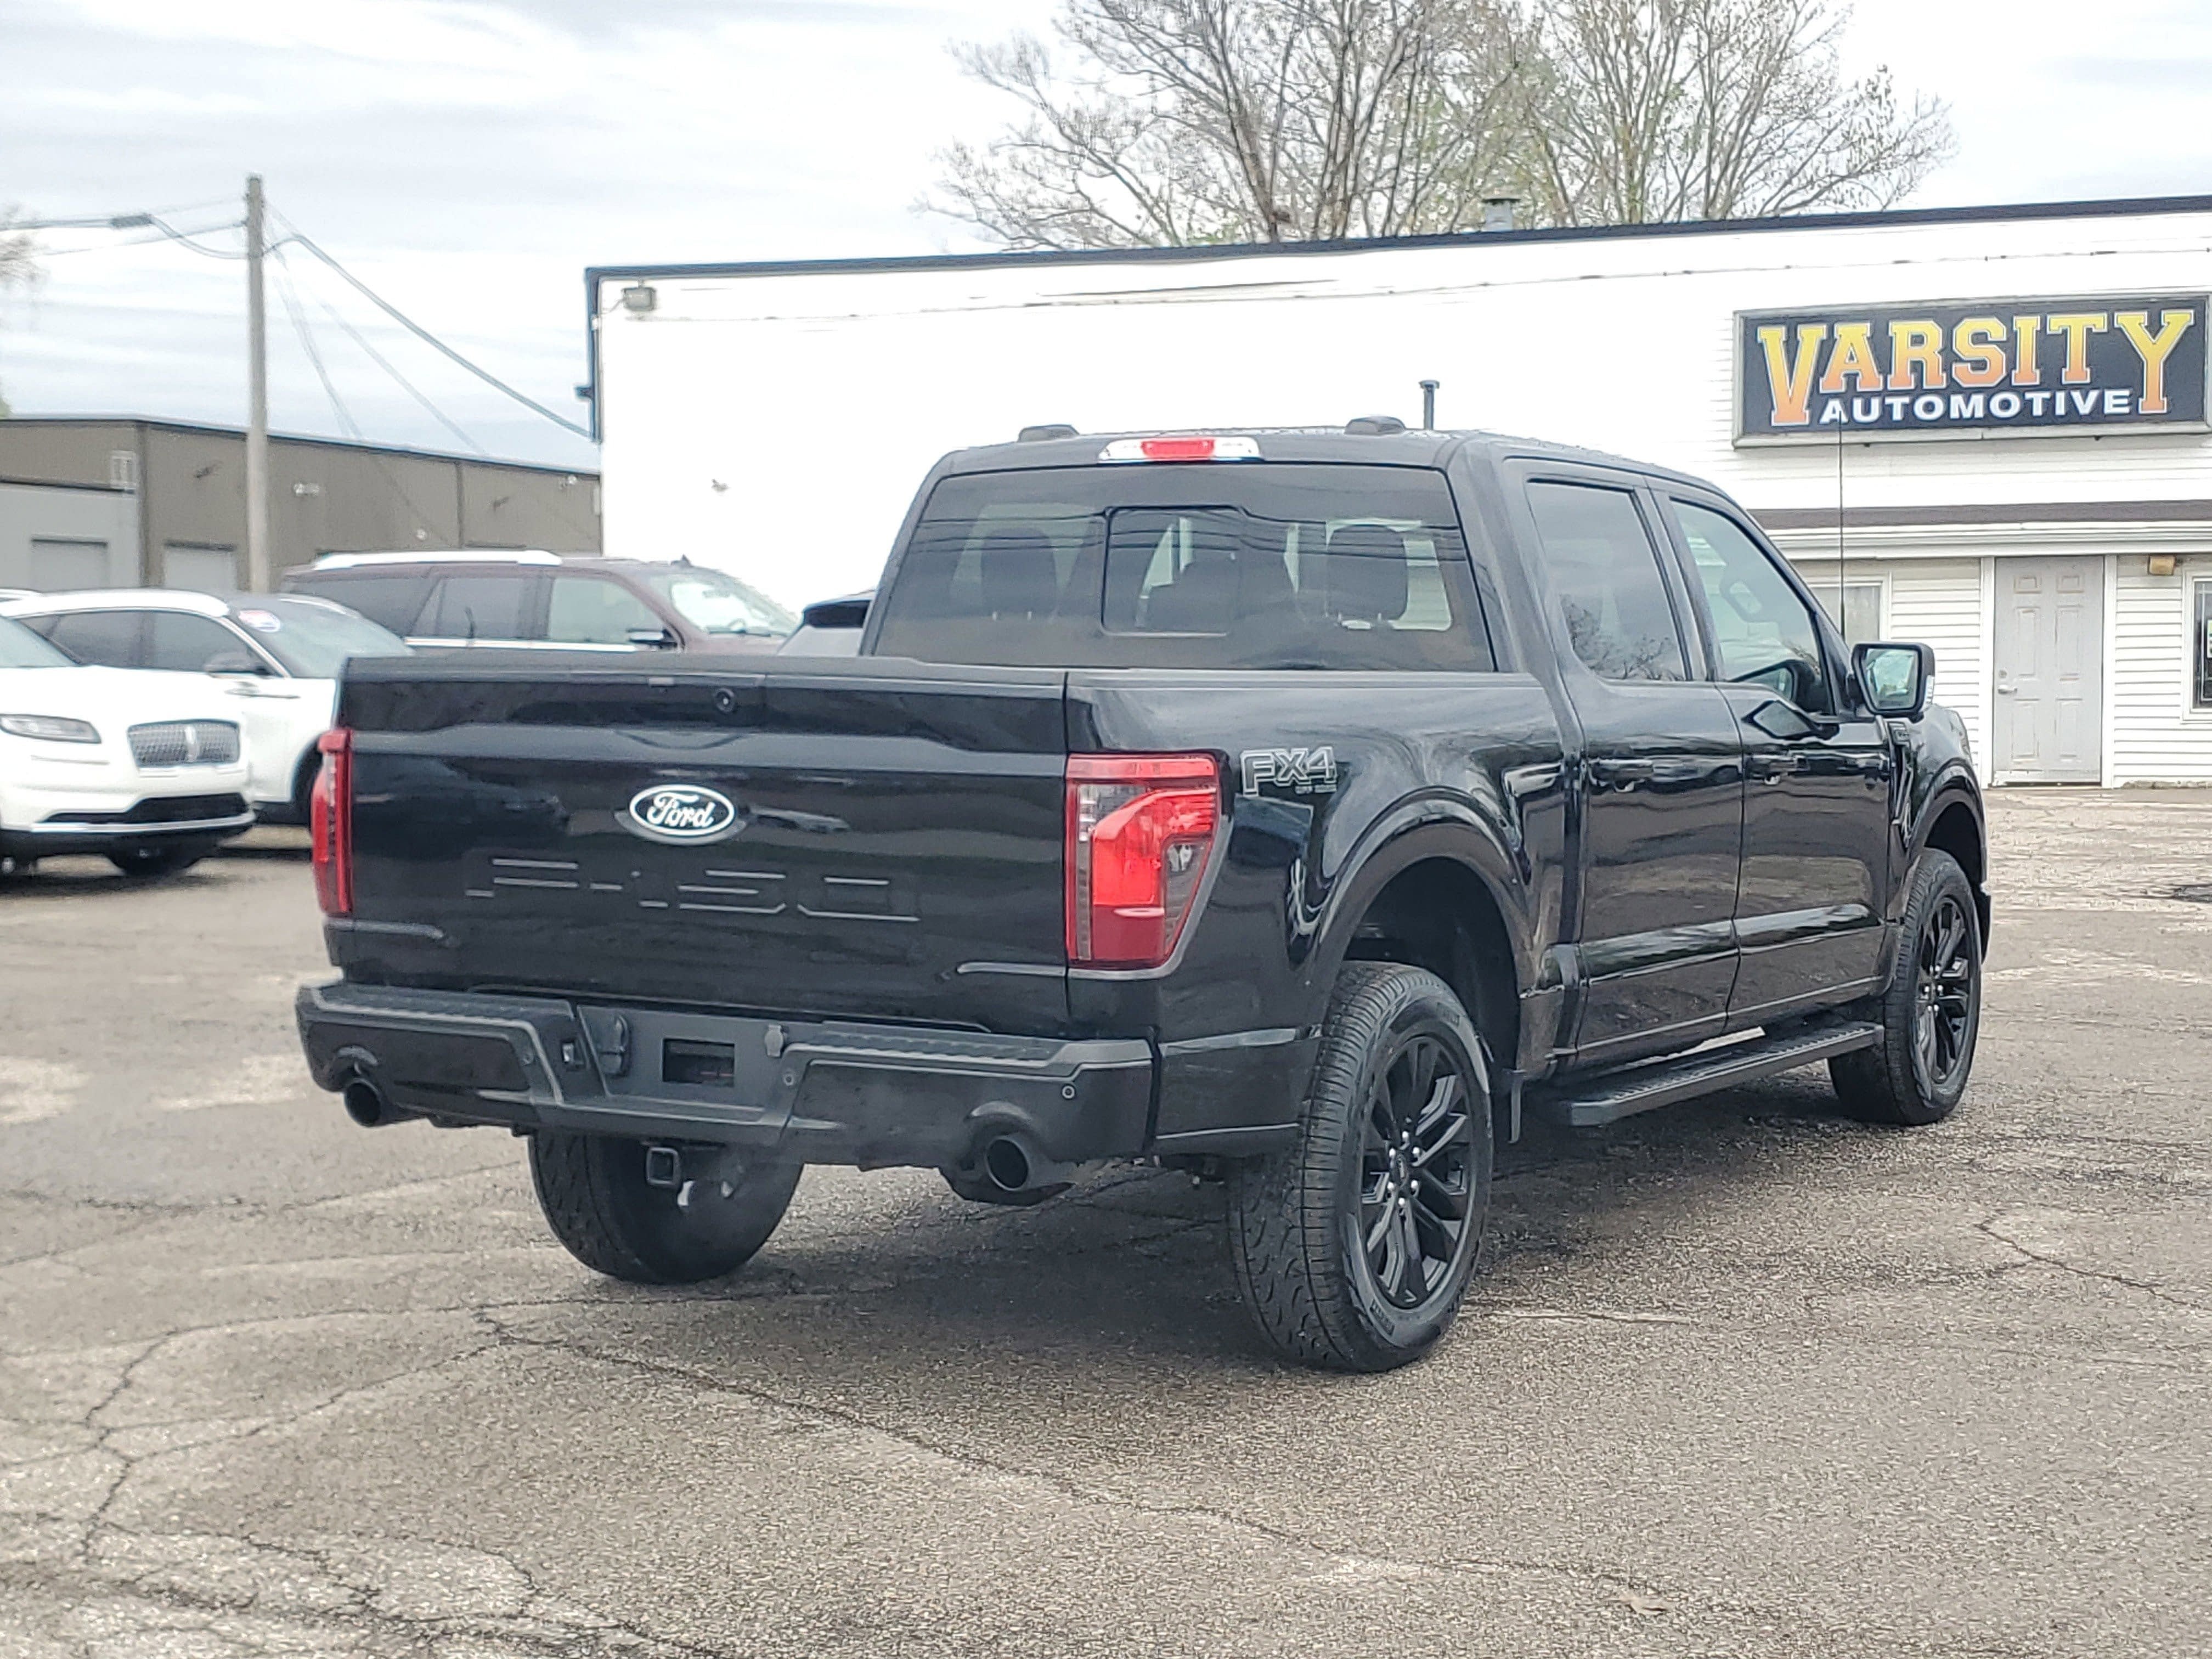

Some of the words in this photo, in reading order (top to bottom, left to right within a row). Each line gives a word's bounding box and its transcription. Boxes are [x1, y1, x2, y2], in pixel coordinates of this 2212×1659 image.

[1757, 309, 2194, 426] VARSITY
[1819, 389, 2131, 425] AUTOMOTIVE
[1240, 746, 1338, 797] FX4
[646, 792, 716, 827] Ford
